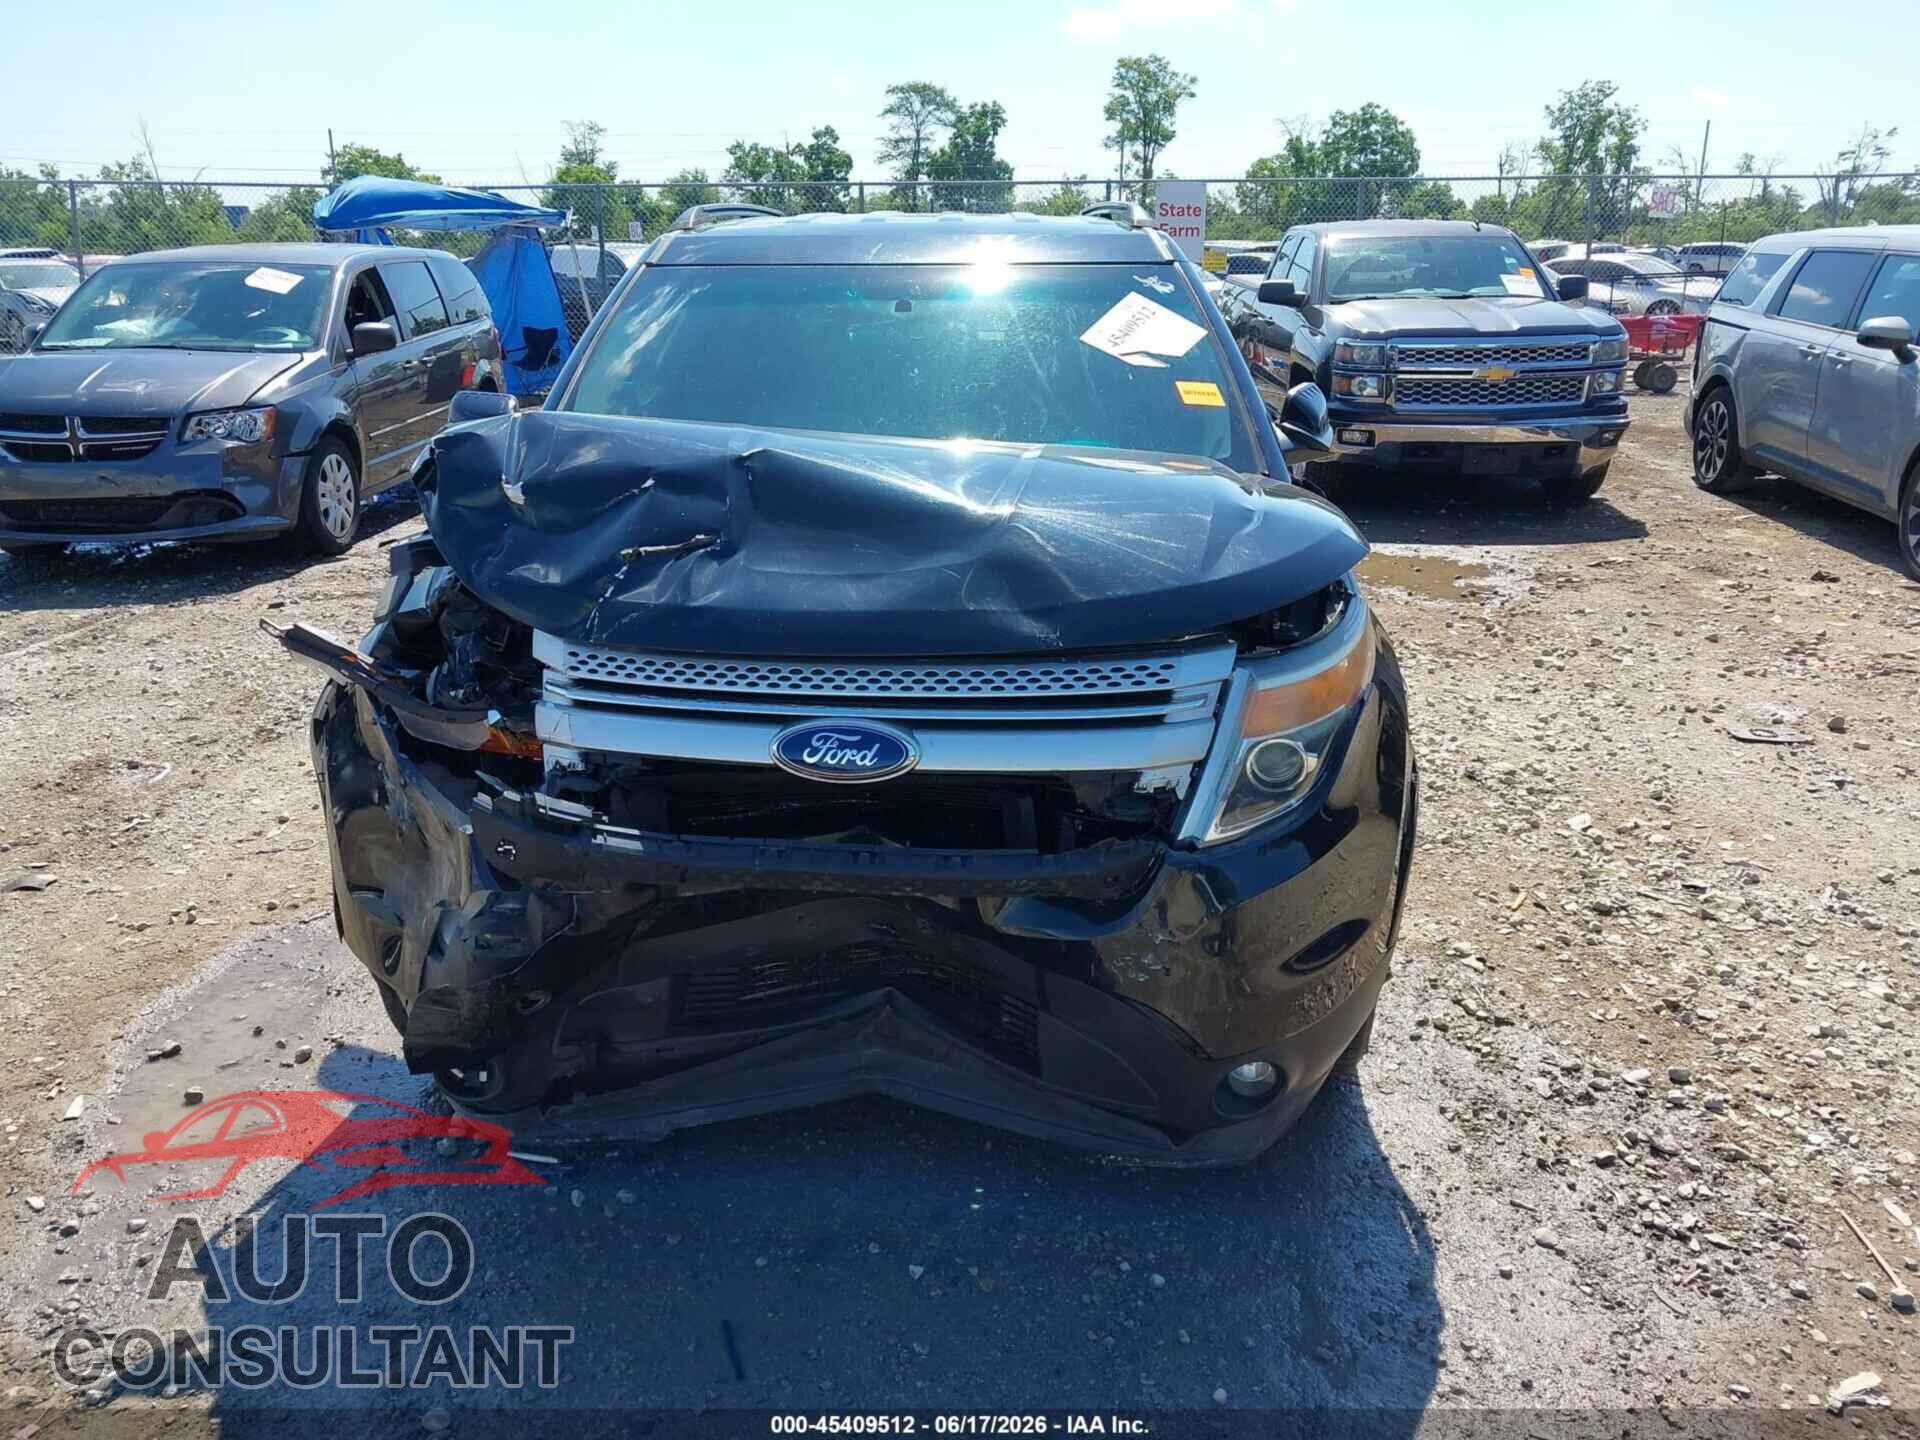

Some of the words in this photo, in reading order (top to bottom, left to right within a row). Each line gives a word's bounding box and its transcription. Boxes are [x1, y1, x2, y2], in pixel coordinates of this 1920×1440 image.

[1159, 202, 1202, 217] State
[1159, 223, 1200, 238] Farm
[1107, 306, 1157, 348] 45409512
[802, 732, 880, 767] Ford
